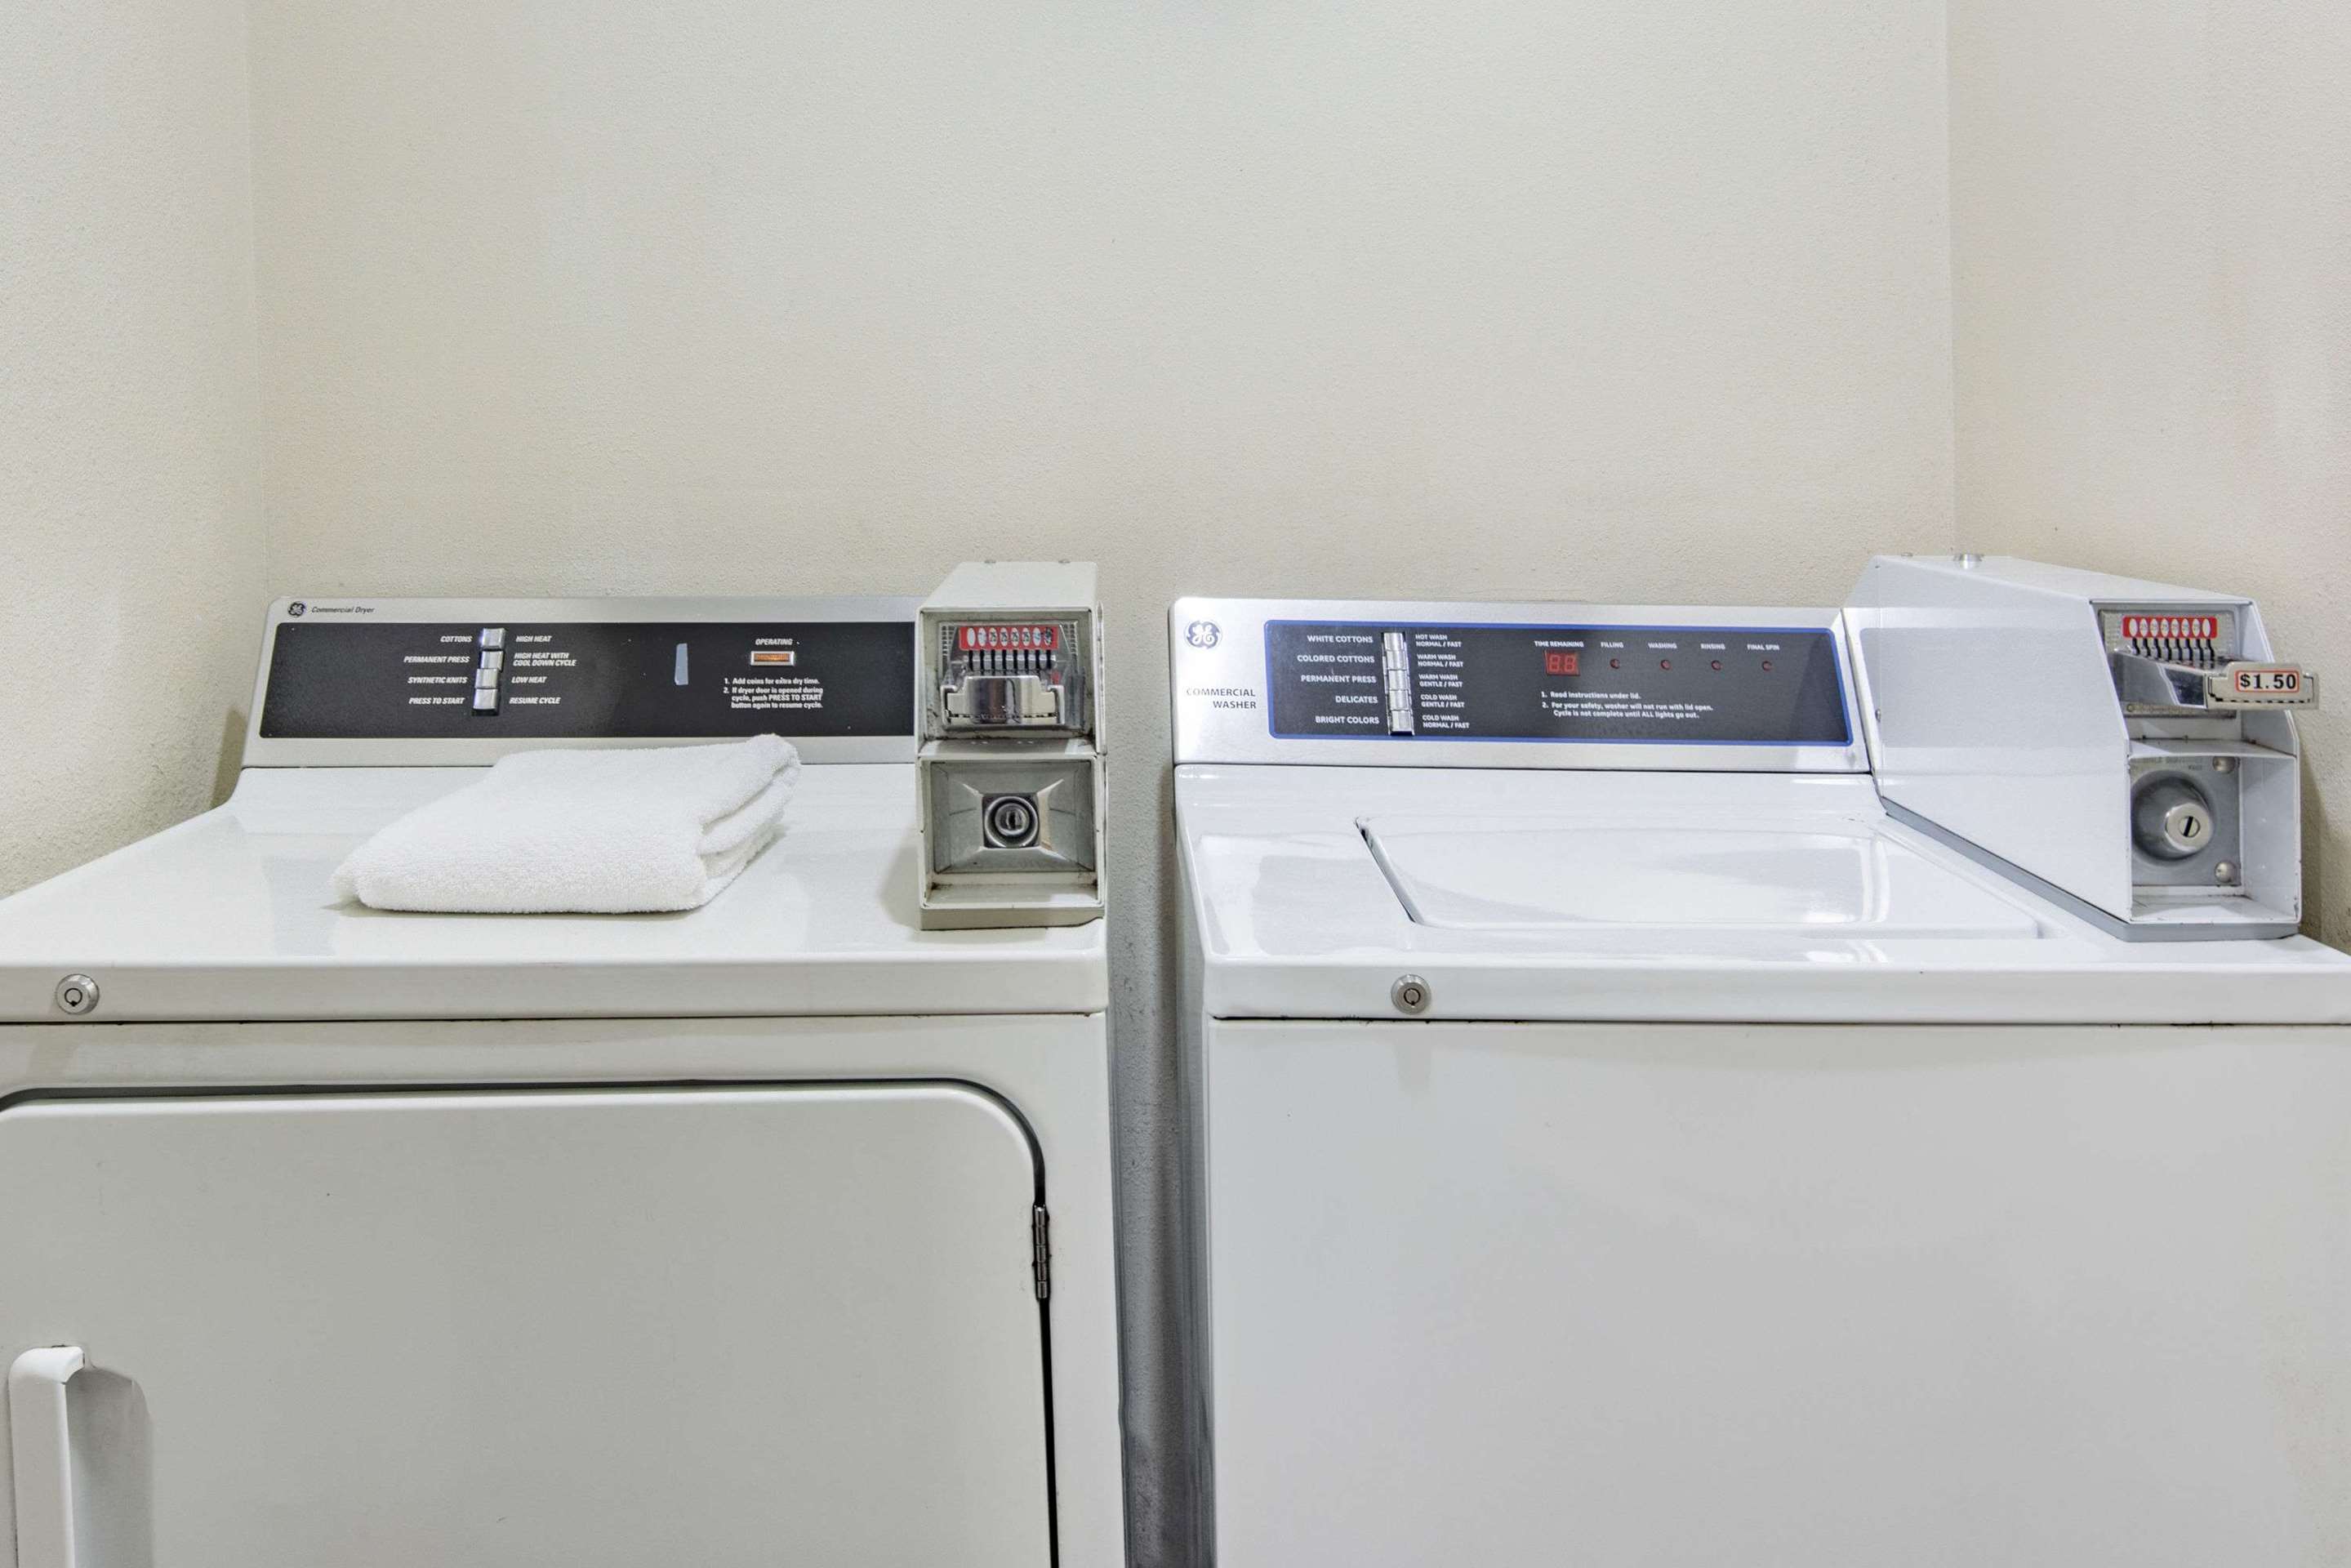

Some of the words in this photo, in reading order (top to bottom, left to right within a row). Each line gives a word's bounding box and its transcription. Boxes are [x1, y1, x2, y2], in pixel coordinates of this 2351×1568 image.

[355, 606, 375, 614] Dryer
[1307, 635, 1334, 644] WHITE
[1335, 635, 1374, 644] COTTONS
[1297, 655, 1335, 663] COLORED
[1337, 655, 1375, 663] COTTONS
[407, 676, 445, 684] SYNTHETIC
[447, 676, 468, 684] KNITS
[1301, 675, 1351, 684] PERMANENT
[1352, 675, 1377, 684] PRESS
[2239, 673, 2296, 690] $1.50
[1186, 688, 1256, 697] COMMERCIAL
[751, 694, 768, 702] push
[1335, 696, 1378, 704] DELICATES
[1213, 701, 1258, 709] WASHER
[1553, 709, 1571, 717] Cycle
[1654, 710, 1674, 719] lights
[1315, 715, 1345, 725] BRIGHT
[1347, 715, 1380, 725] COLORS
